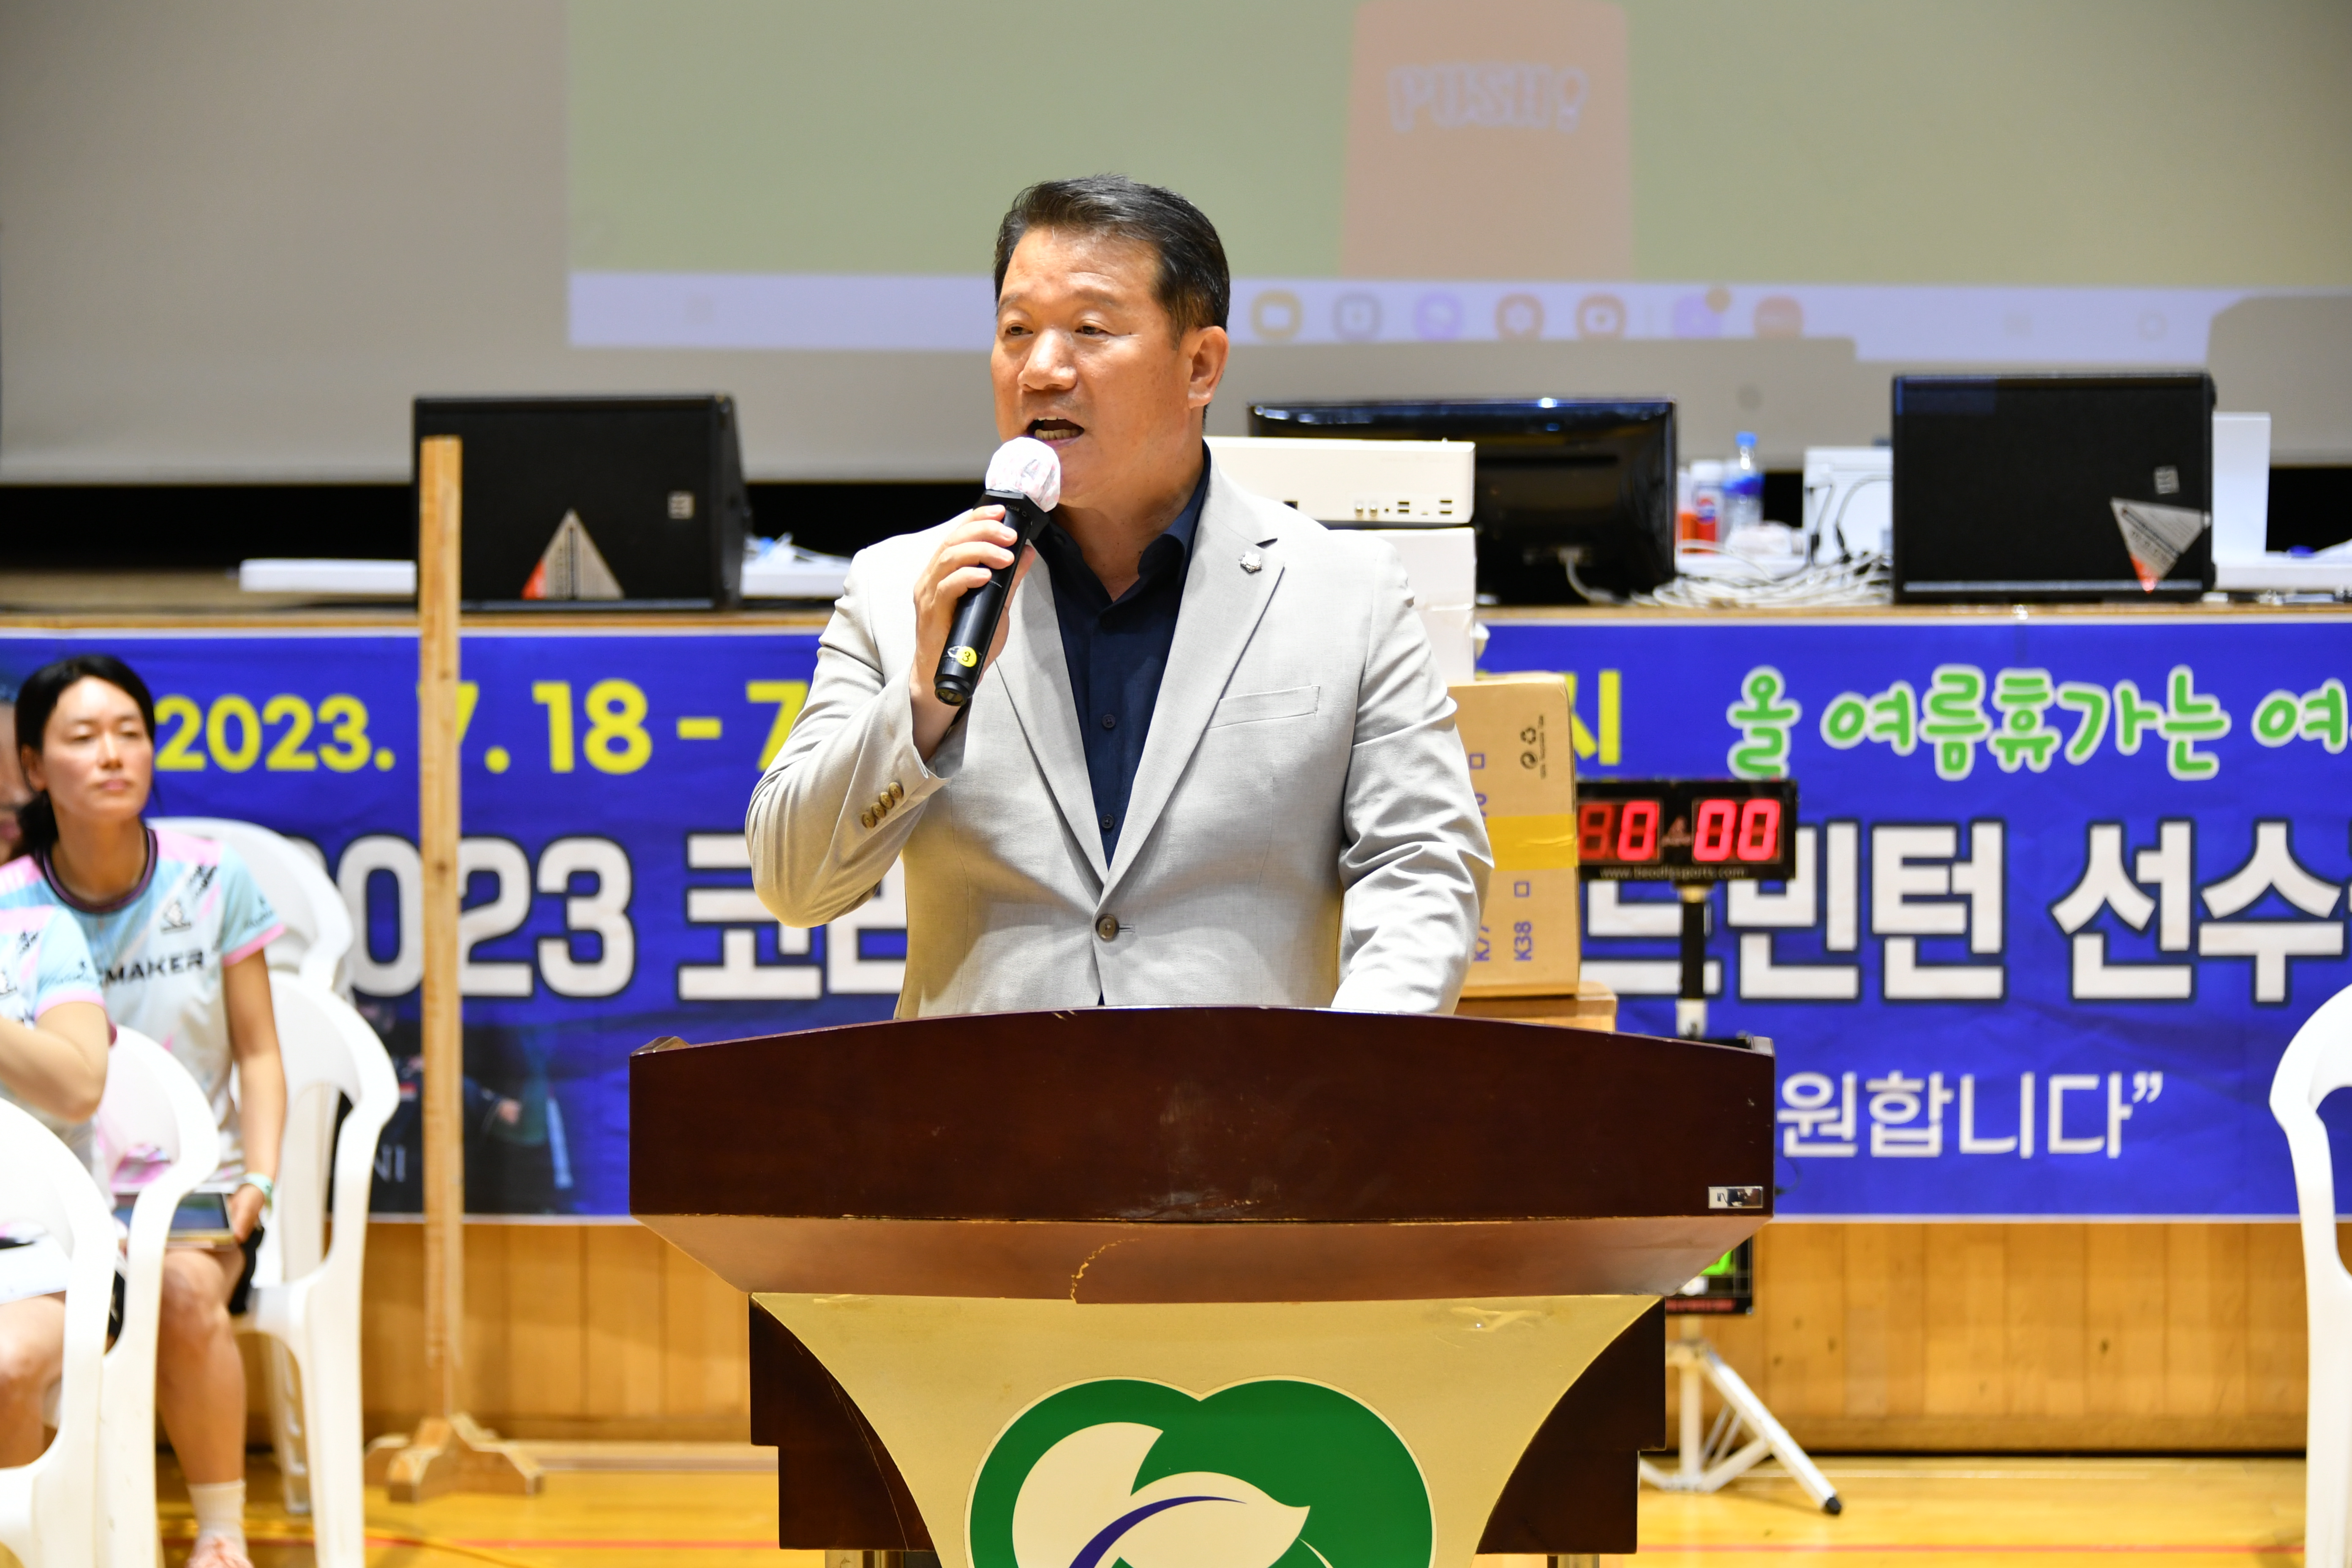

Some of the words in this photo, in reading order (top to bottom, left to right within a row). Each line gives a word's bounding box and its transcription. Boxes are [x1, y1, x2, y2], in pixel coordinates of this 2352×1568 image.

[962, 651, 971, 662] 3
[155, 694, 396, 773] 2023.
[1729, 665, 1801, 779] 올
[1820, 664, 2231, 781] 여름휴가는
[2252, 678, 2352, 754] 여
[287, 834, 636, 998] 023
[2051, 821, 2352, 1003] 선수
[1514, 921, 1532, 961] K38
[97, 950, 204, 985] MAKER
